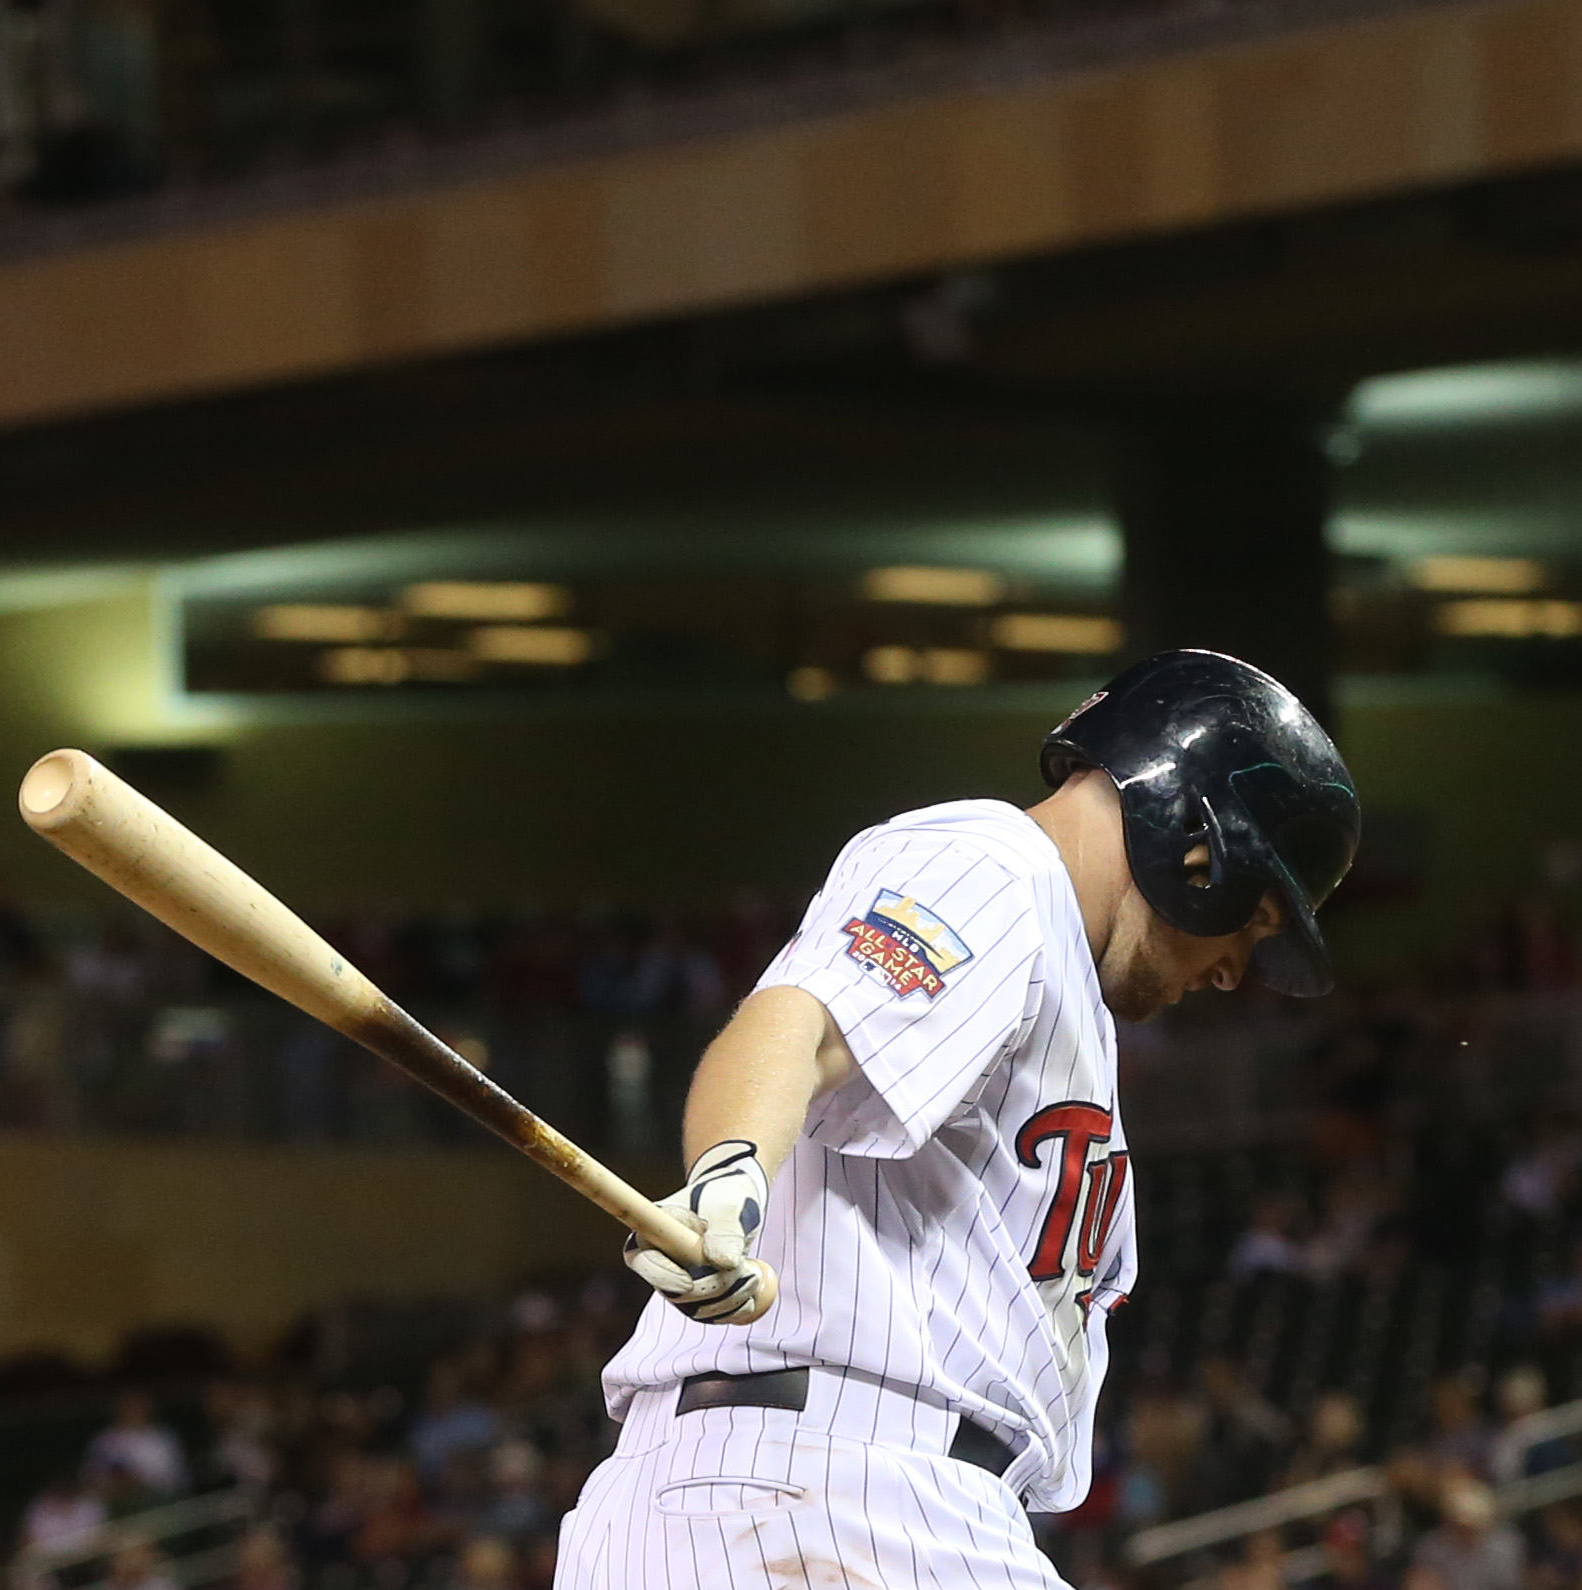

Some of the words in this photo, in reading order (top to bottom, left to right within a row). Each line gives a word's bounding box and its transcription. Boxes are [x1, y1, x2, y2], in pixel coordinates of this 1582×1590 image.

[849, 924, 886, 949] ALL
[891, 947, 938, 991] STAR
[859, 941, 913, 986] GAME
